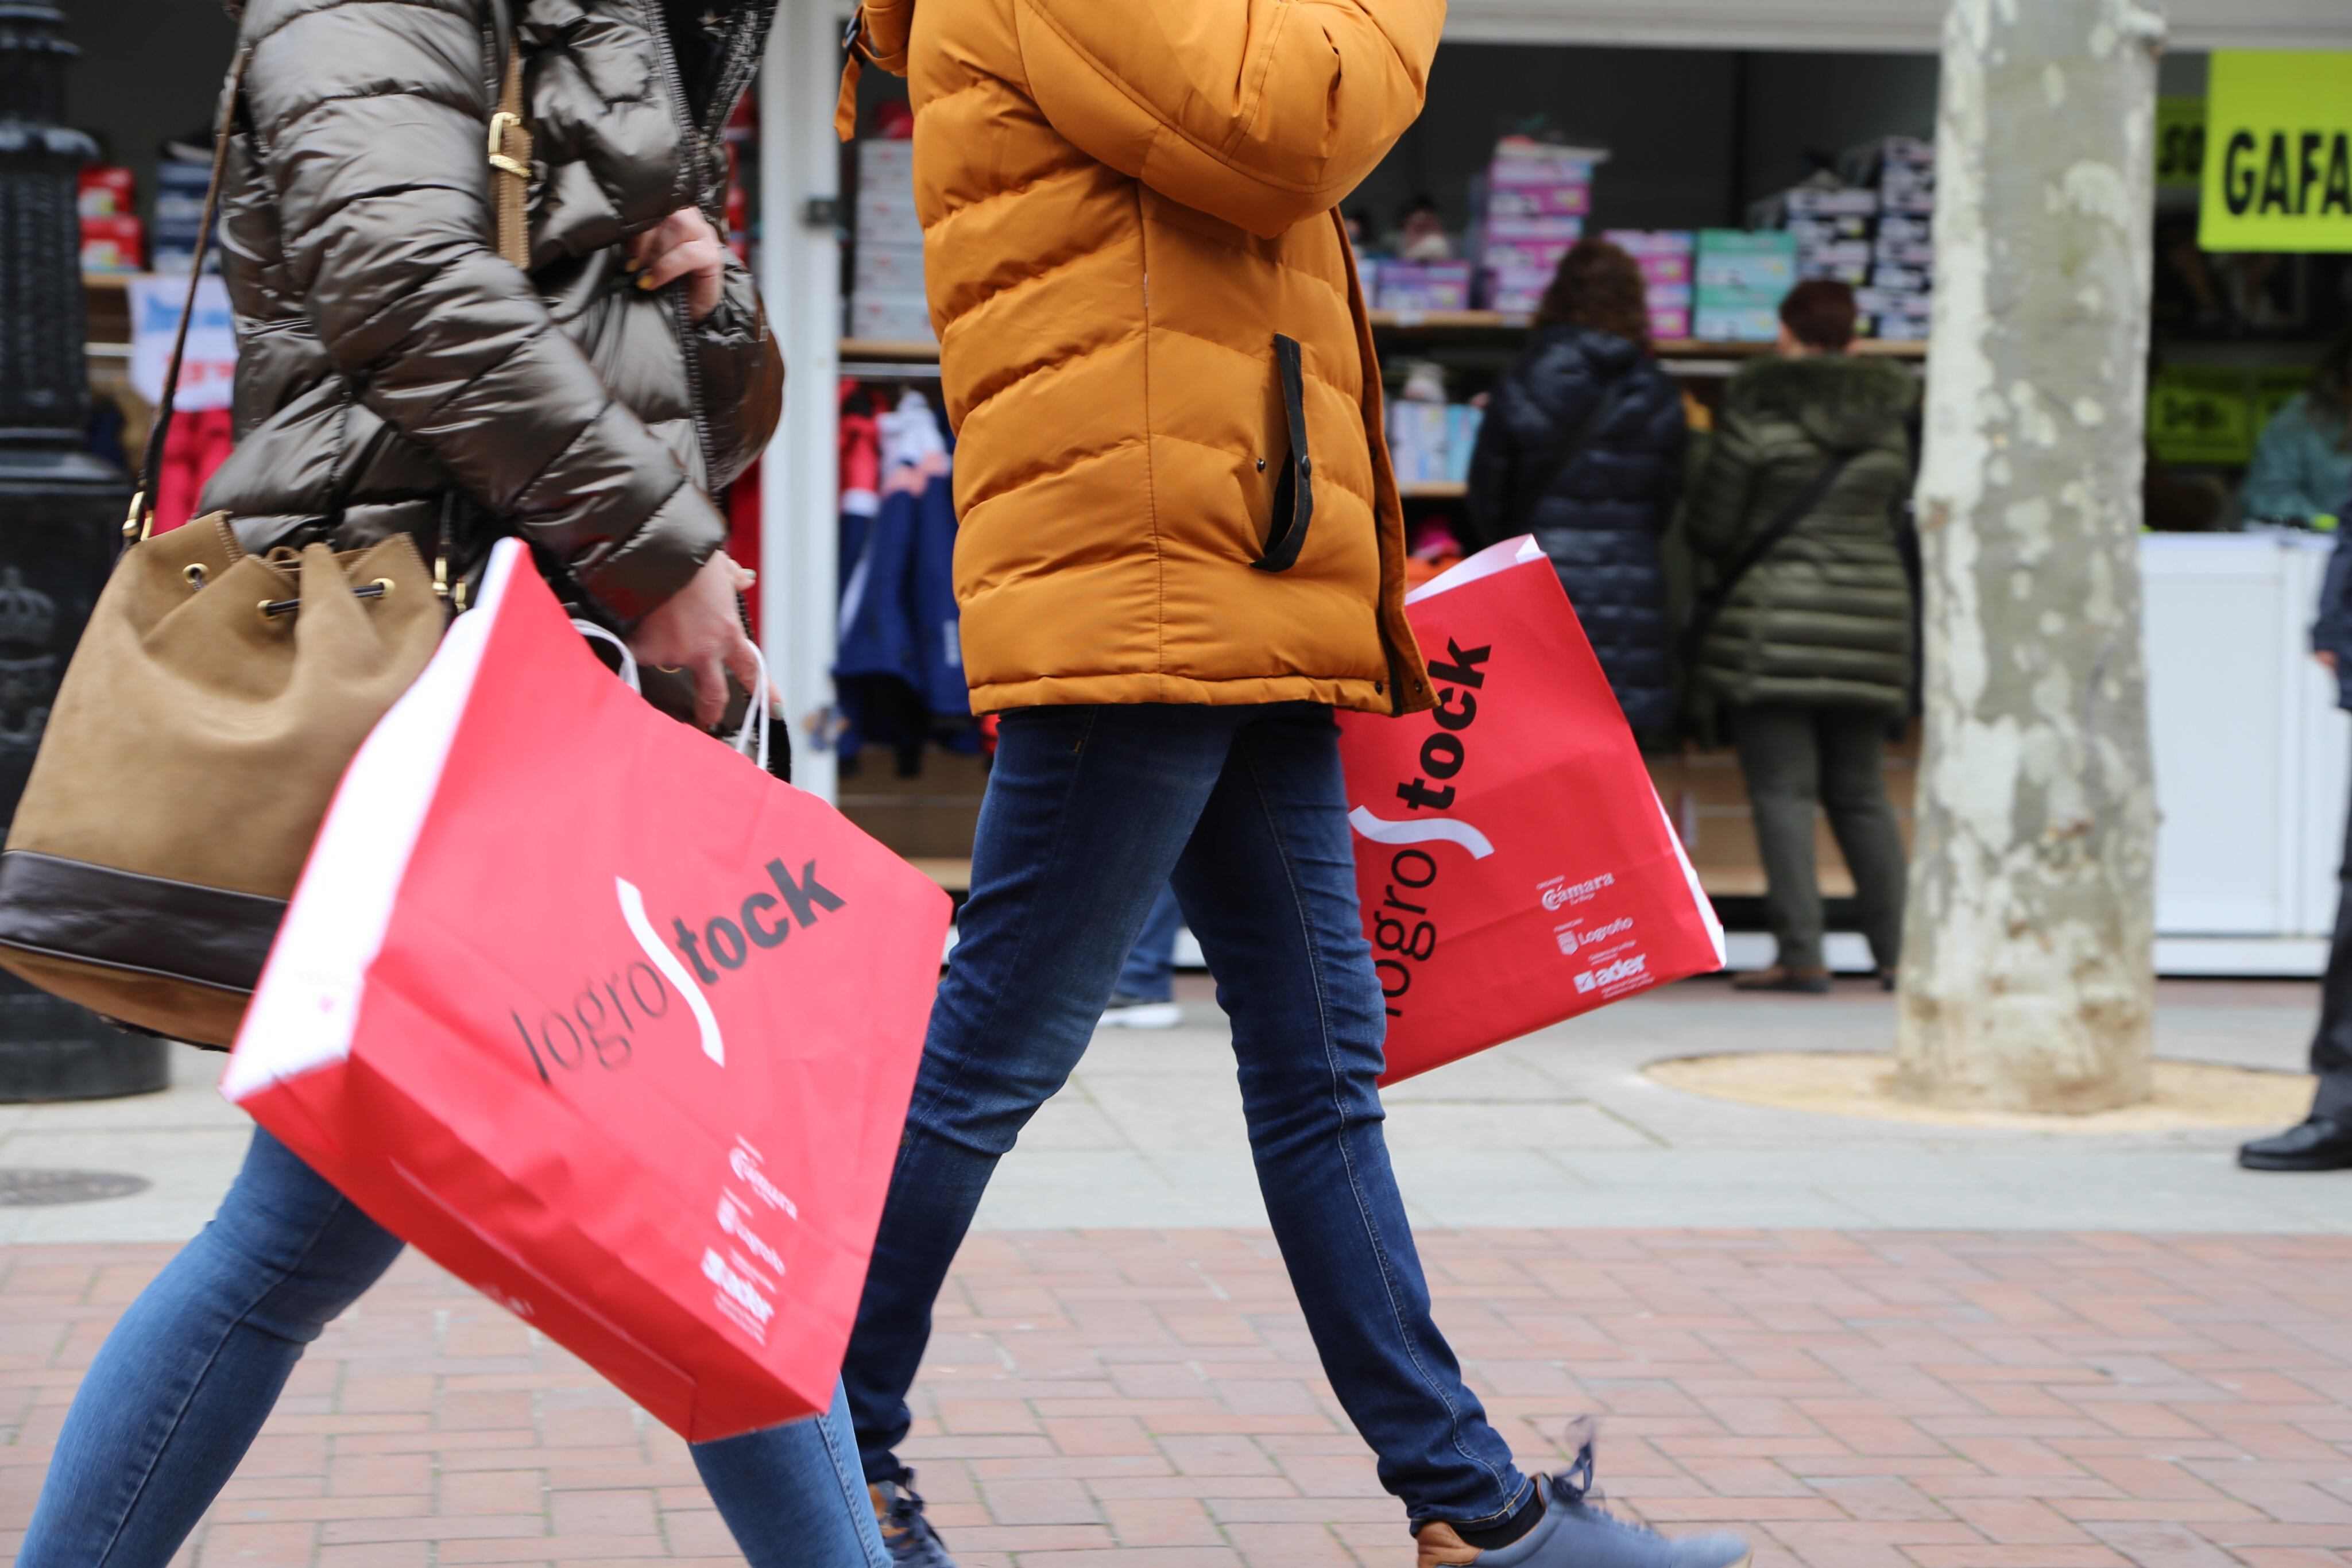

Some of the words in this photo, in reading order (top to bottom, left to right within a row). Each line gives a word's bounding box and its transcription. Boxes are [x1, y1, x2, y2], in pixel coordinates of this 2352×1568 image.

[2224, 131, 2352, 216] GAFA
[1542, 872, 1615, 911] Cámara
[1595, 953, 1646, 986] ader
